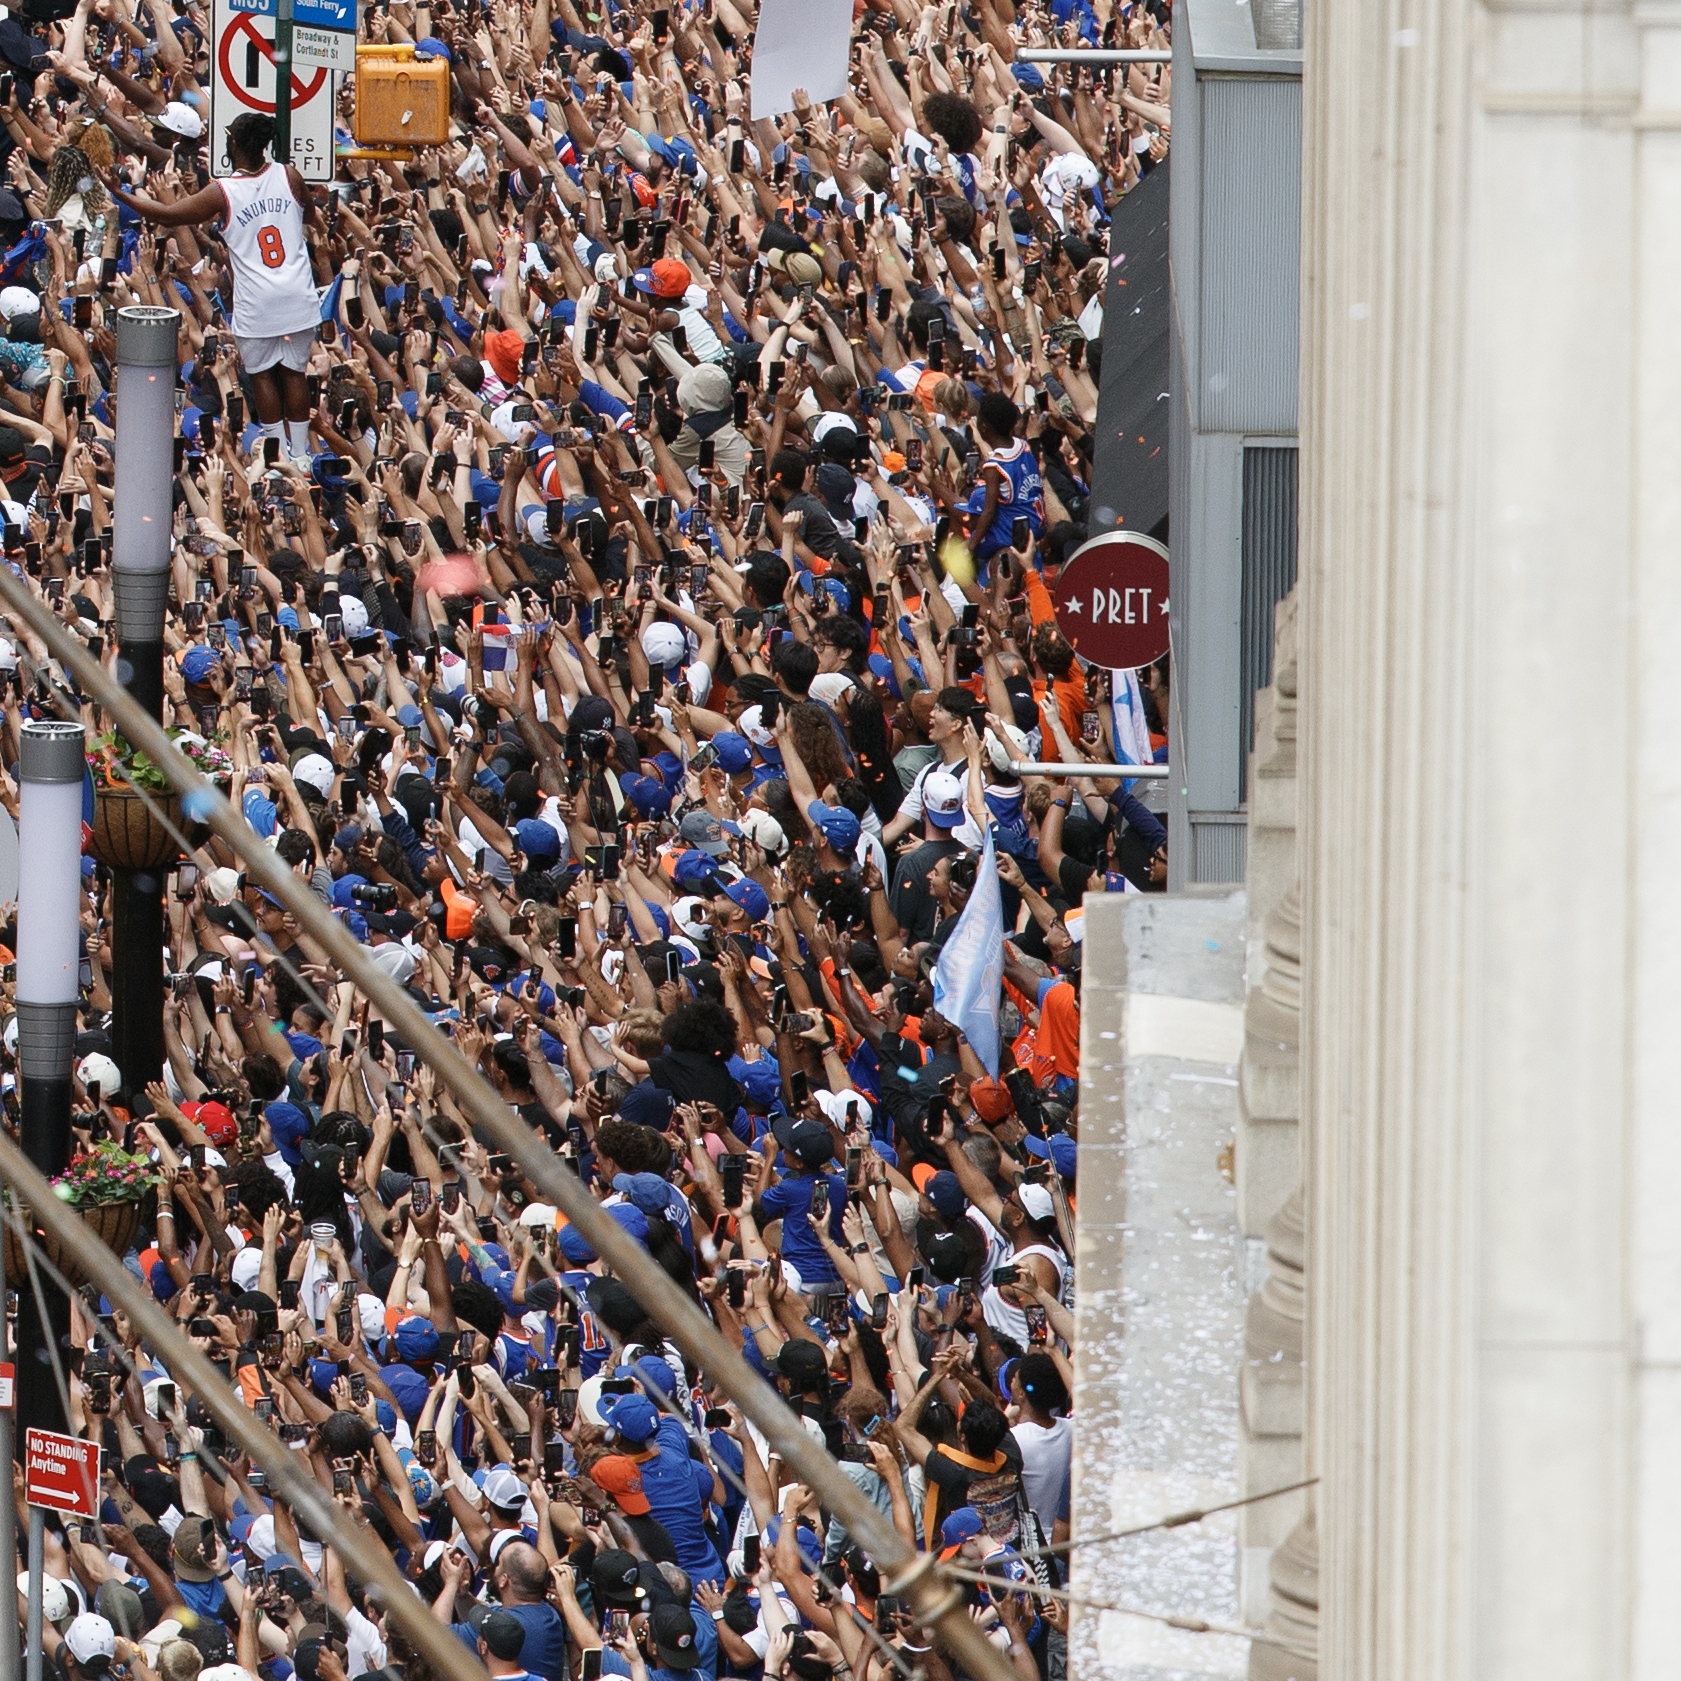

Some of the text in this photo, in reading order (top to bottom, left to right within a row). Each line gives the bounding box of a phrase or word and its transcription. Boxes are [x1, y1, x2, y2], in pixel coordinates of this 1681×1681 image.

[296, 28, 339, 46] Broadway &
[296, 44, 339, 59] Cortlandt St
[303, 157, 324, 171] FT
[235, 197, 292, 227] ANUNOBY
[257, 224, 286, 269] 8
[1092, 587, 1152, 624] PRET
[31, 1437, 88, 1463] NO STANDING
[31, 1456, 67, 1477] Anytime
